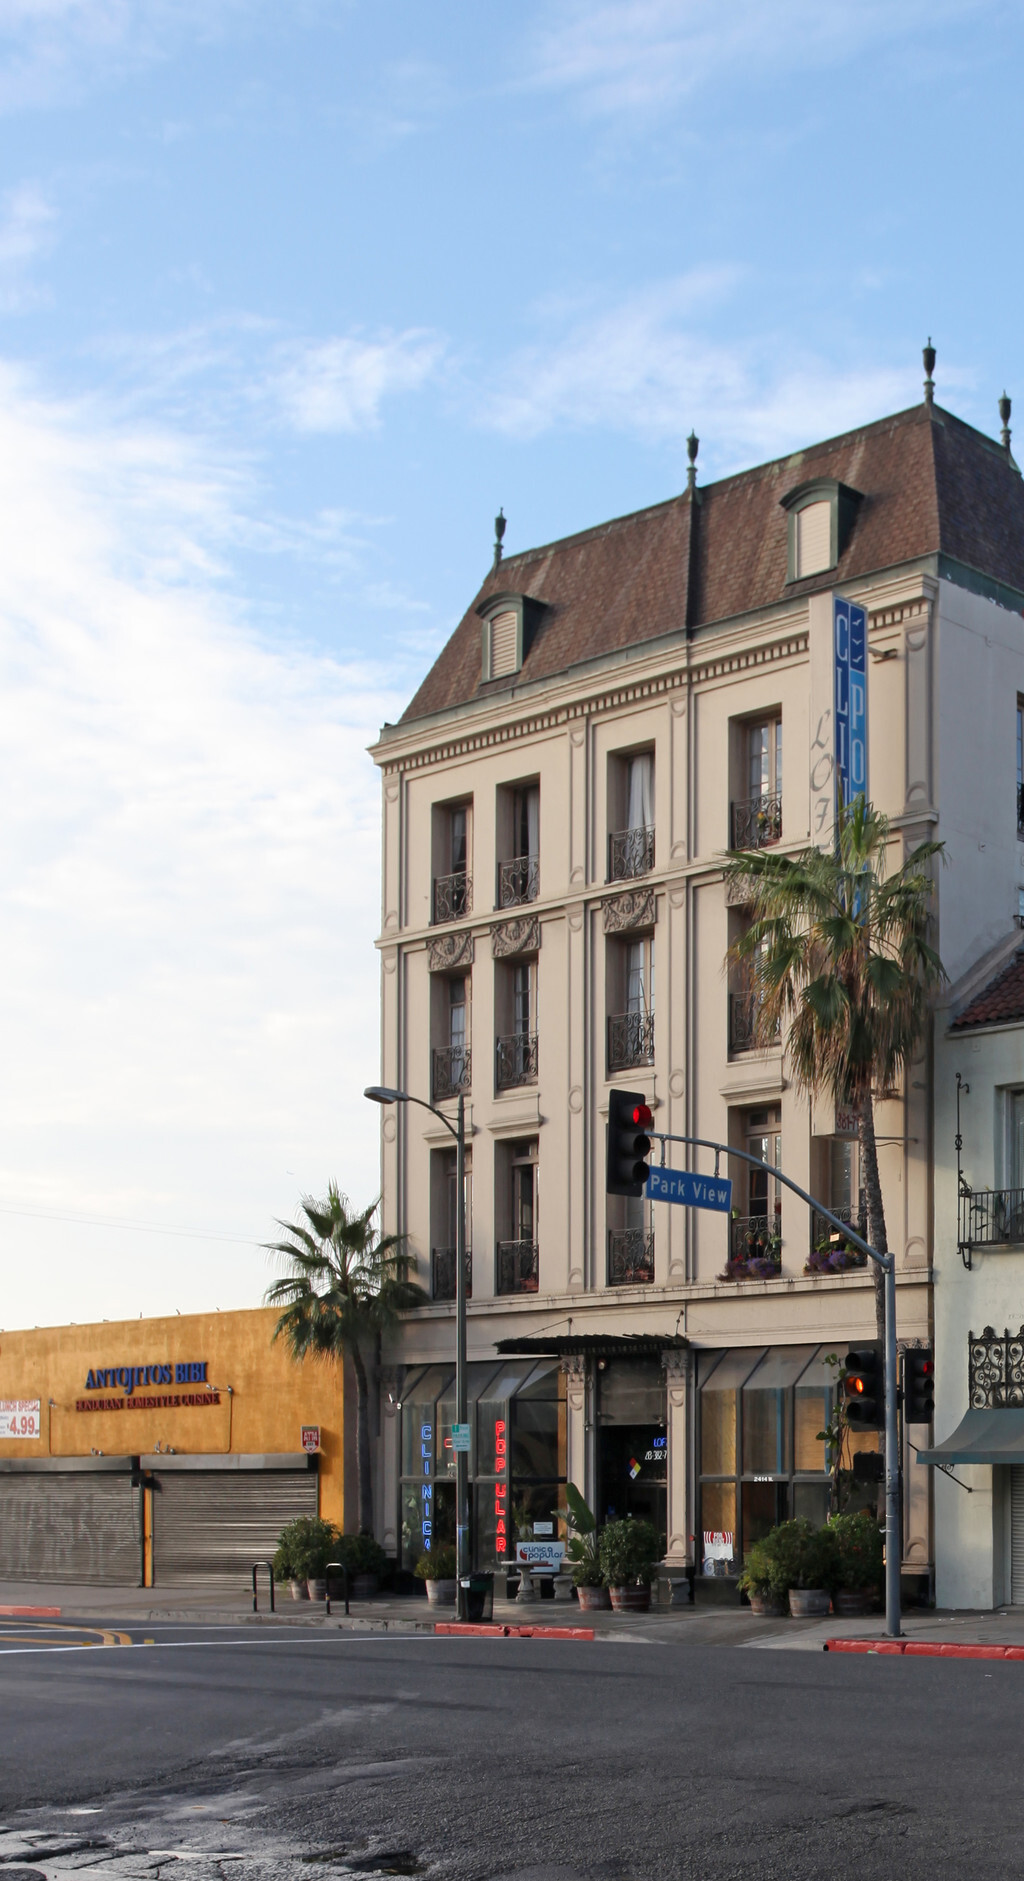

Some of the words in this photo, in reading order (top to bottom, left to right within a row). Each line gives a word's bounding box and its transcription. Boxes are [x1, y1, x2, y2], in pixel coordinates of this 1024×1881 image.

[651, 1174, 686, 1197] Park
[692, 1181, 728, 1204] View
[85, 1364, 172, 1396] ANTOJITOS
[175, 1361, 208, 1384] BIBI
[76, 1397, 125, 1412] HONDURAN
[127, 1394, 181, 1410] HOMESTYLE
[181, 1392, 221, 1407] CUISINE
[303, 1431, 318, 1442] ATM
[653, 1437, 667, 1448] LOF
[494, 1419, 507, 1553] POPULAR
[528, 1551, 563, 1560] popular
